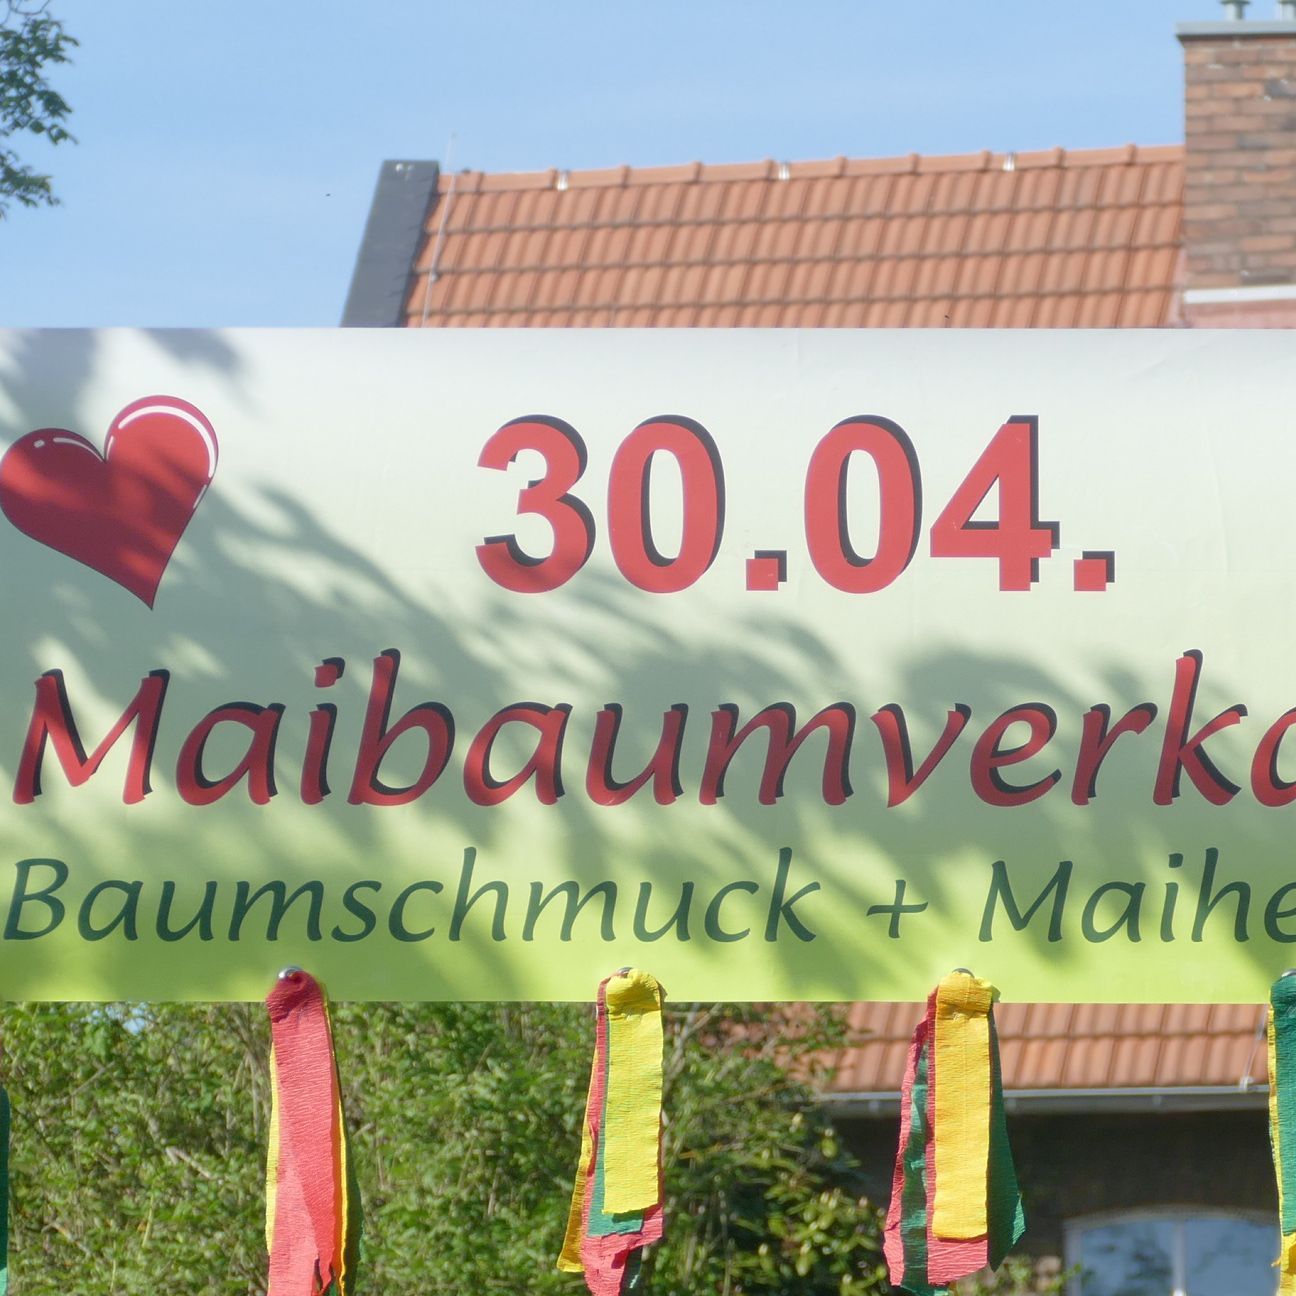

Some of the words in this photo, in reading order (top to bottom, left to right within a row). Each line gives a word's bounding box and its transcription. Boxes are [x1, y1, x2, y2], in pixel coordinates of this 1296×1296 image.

[475, 414, 1116, 595] 30.04.
[3, 847, 822, 944] Baumschmuck
[866, 879, 929, 940] +
